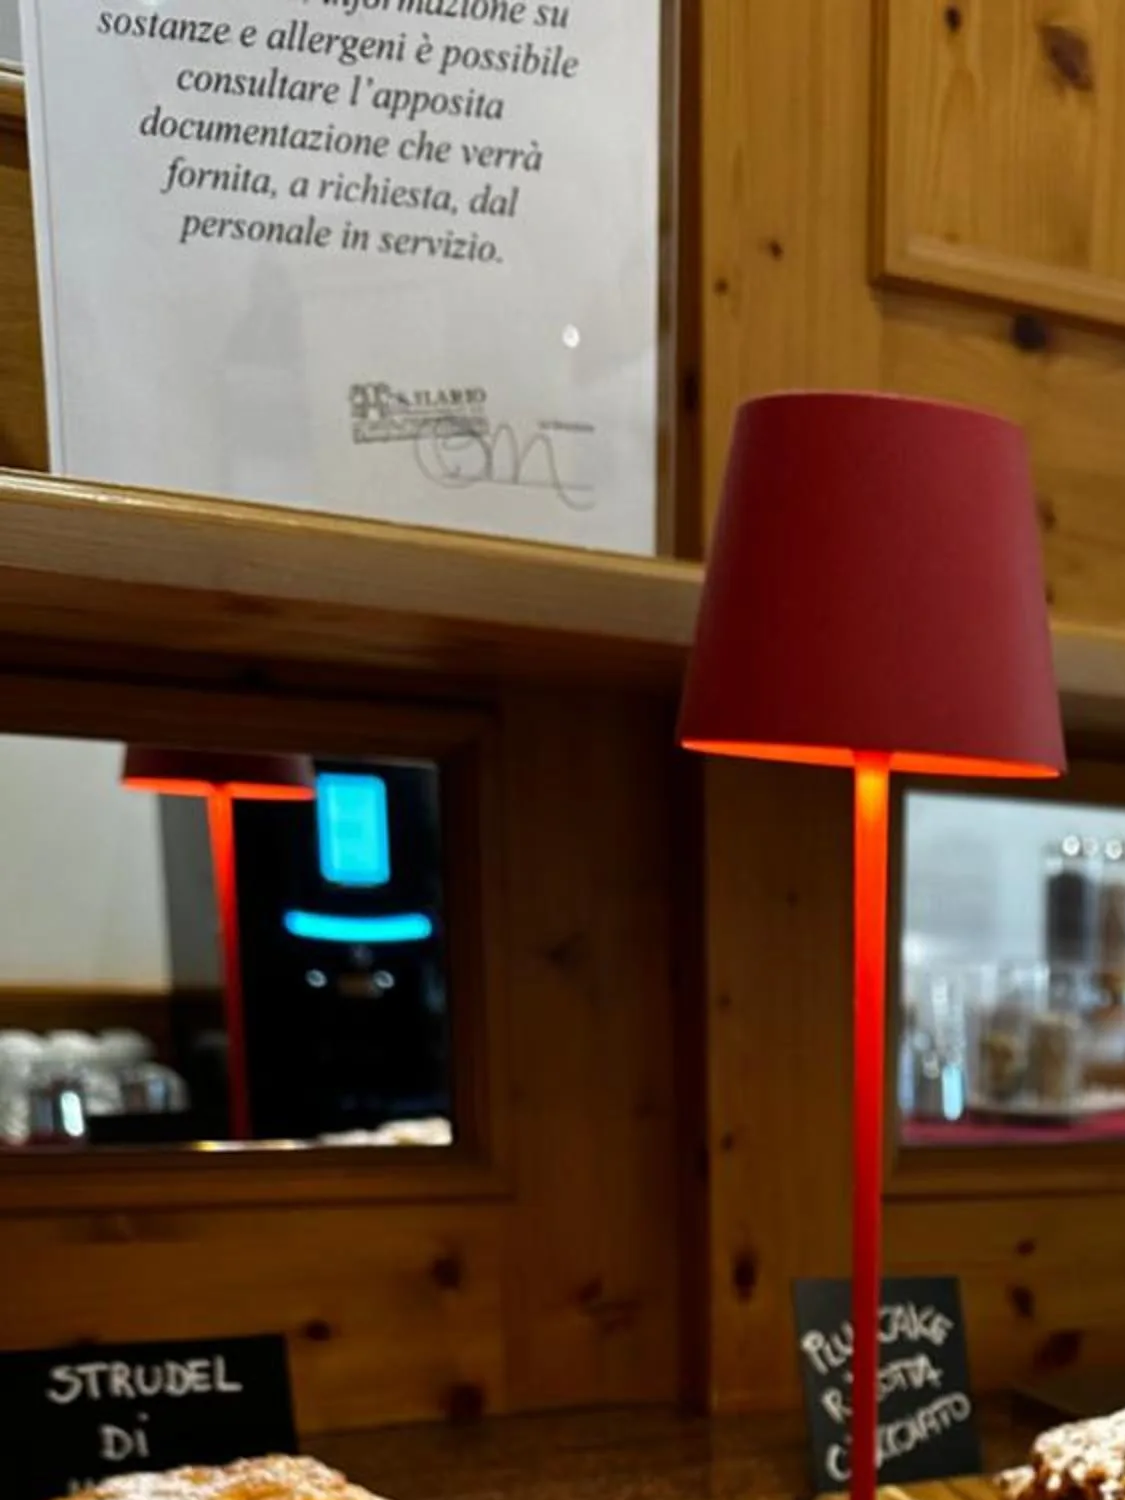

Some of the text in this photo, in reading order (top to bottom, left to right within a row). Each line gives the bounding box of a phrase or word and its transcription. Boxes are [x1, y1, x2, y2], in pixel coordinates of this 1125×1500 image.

[534, 3, 569, 28] su
[97, 10, 579, 79] sostanze e allergeni è possibile
[176, 66, 340, 105] consultare
[139, 105, 543, 172] documentazione che verrà
[160, 156, 520, 218] fornita, a richiesta, dal
[178, 214, 504, 264] personale in servizio.
[46, 1355, 242, 1403] STRUDEL
